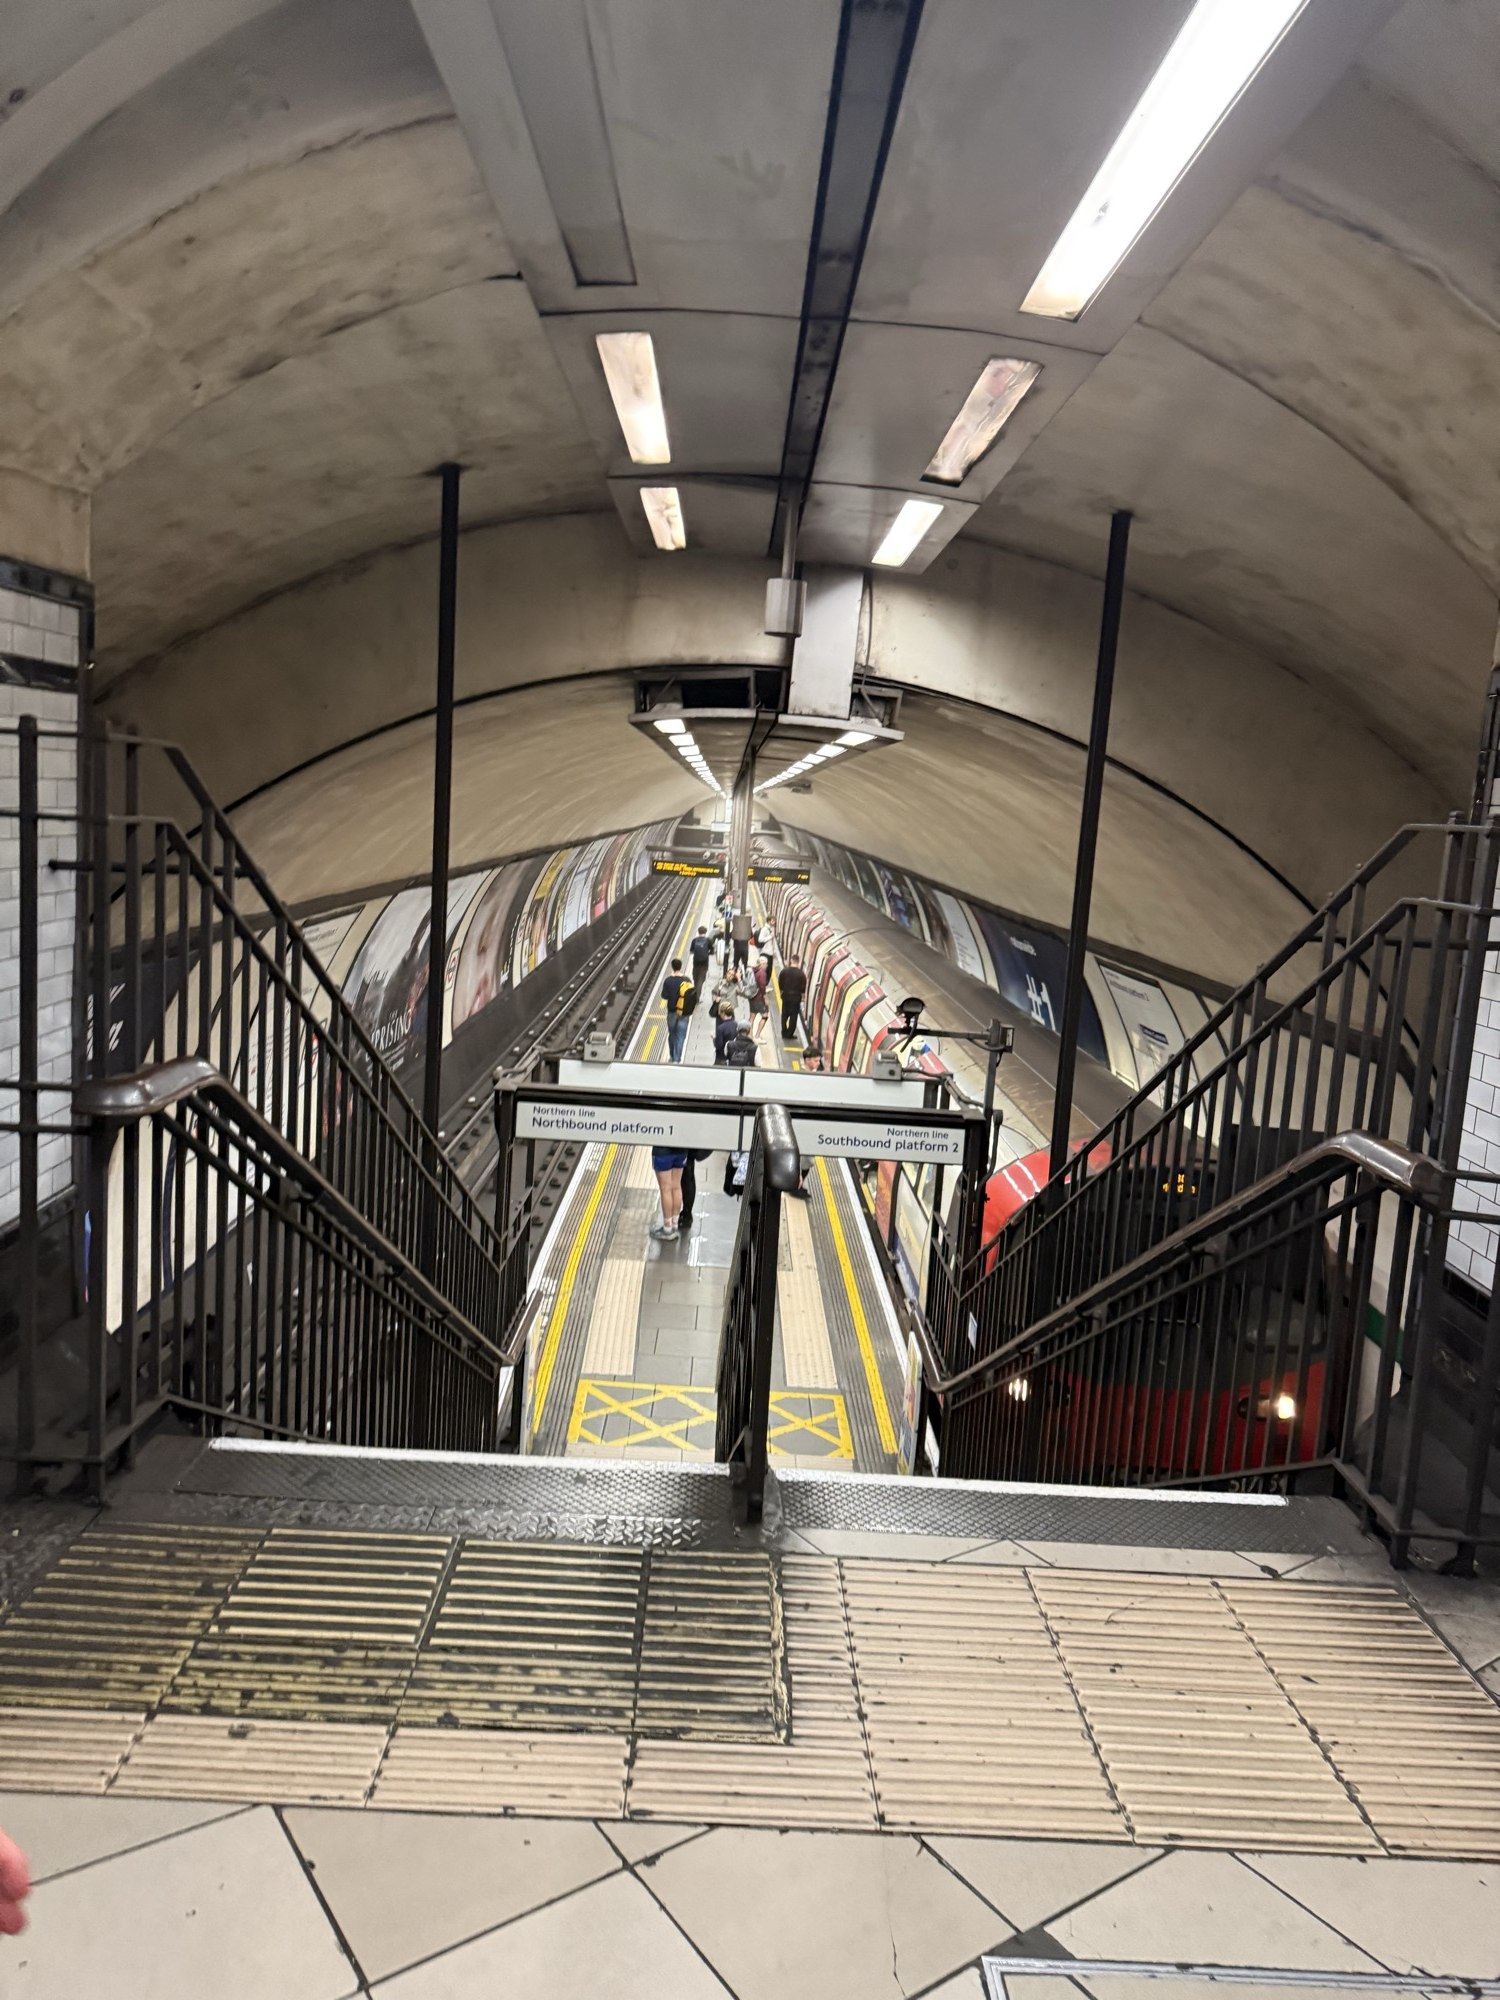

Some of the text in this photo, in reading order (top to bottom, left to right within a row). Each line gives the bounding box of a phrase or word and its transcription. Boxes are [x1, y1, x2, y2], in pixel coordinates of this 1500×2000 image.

[533, 1105, 596, 1117] Northern line
[532, 1116, 674, 1136] Northbound platform 1
[887, 1127, 949, 1139] Northern line
[817, 1134, 959, 1153] Southbound platform 2
